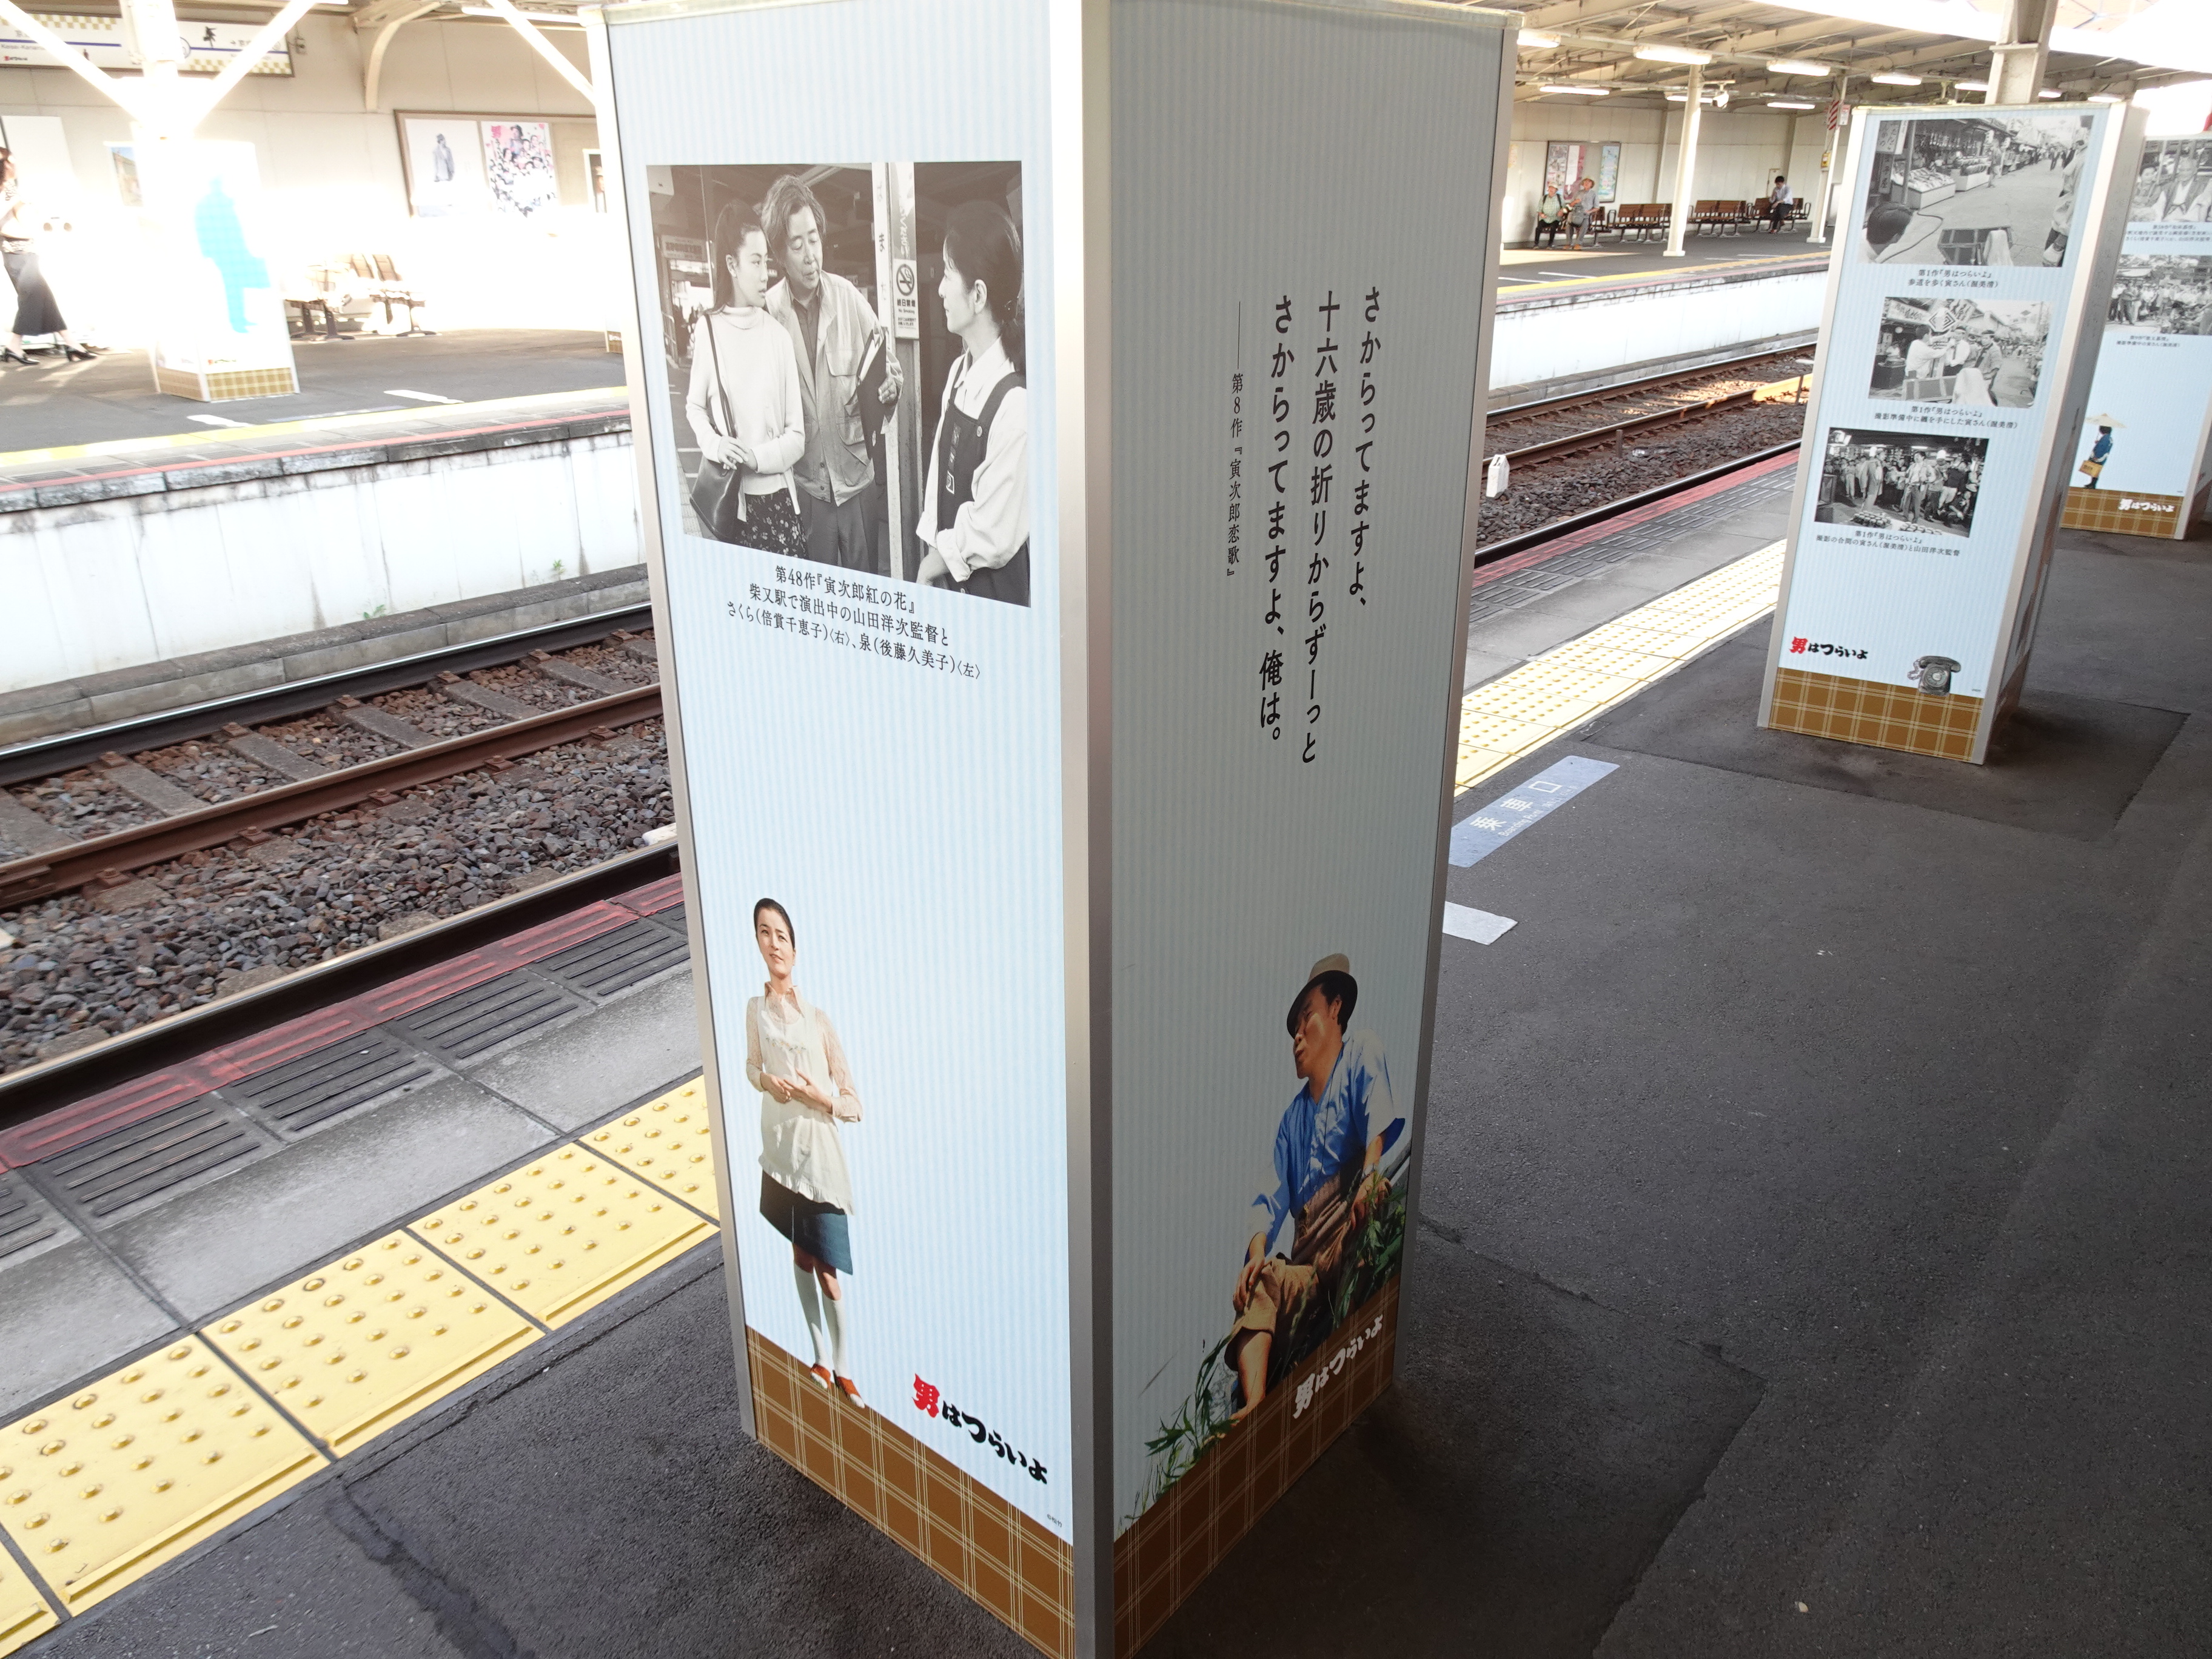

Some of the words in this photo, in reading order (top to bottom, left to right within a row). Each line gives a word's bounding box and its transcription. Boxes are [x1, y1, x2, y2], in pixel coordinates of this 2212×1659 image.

[1349, 286, 1382, 606] さからってますよ、
[1259, 295, 1295, 740] さからってますよ、俺は。
[1302, 290, 1341, 763] 十六歳の折りからずーっと
[2118, 498, 2176, 512] 男はつらいよ
[749, 583, 950, 646] 柴又駅で演出中の山田洋次監督と
[775, 565, 915, 614] 第48作『寅次郎紅の花』
[1789, 637, 1869, 660] 男はつらいよ
[1469, 780, 1563, 831] 乗車口
[1498, 818, 1532, 837] Boarding
[1523, 809, 1545, 821] Point
[1292, 1313, 1383, 1419] 男はつらいよ
[911, 1373, 1048, 1485] 男はつらいよ
